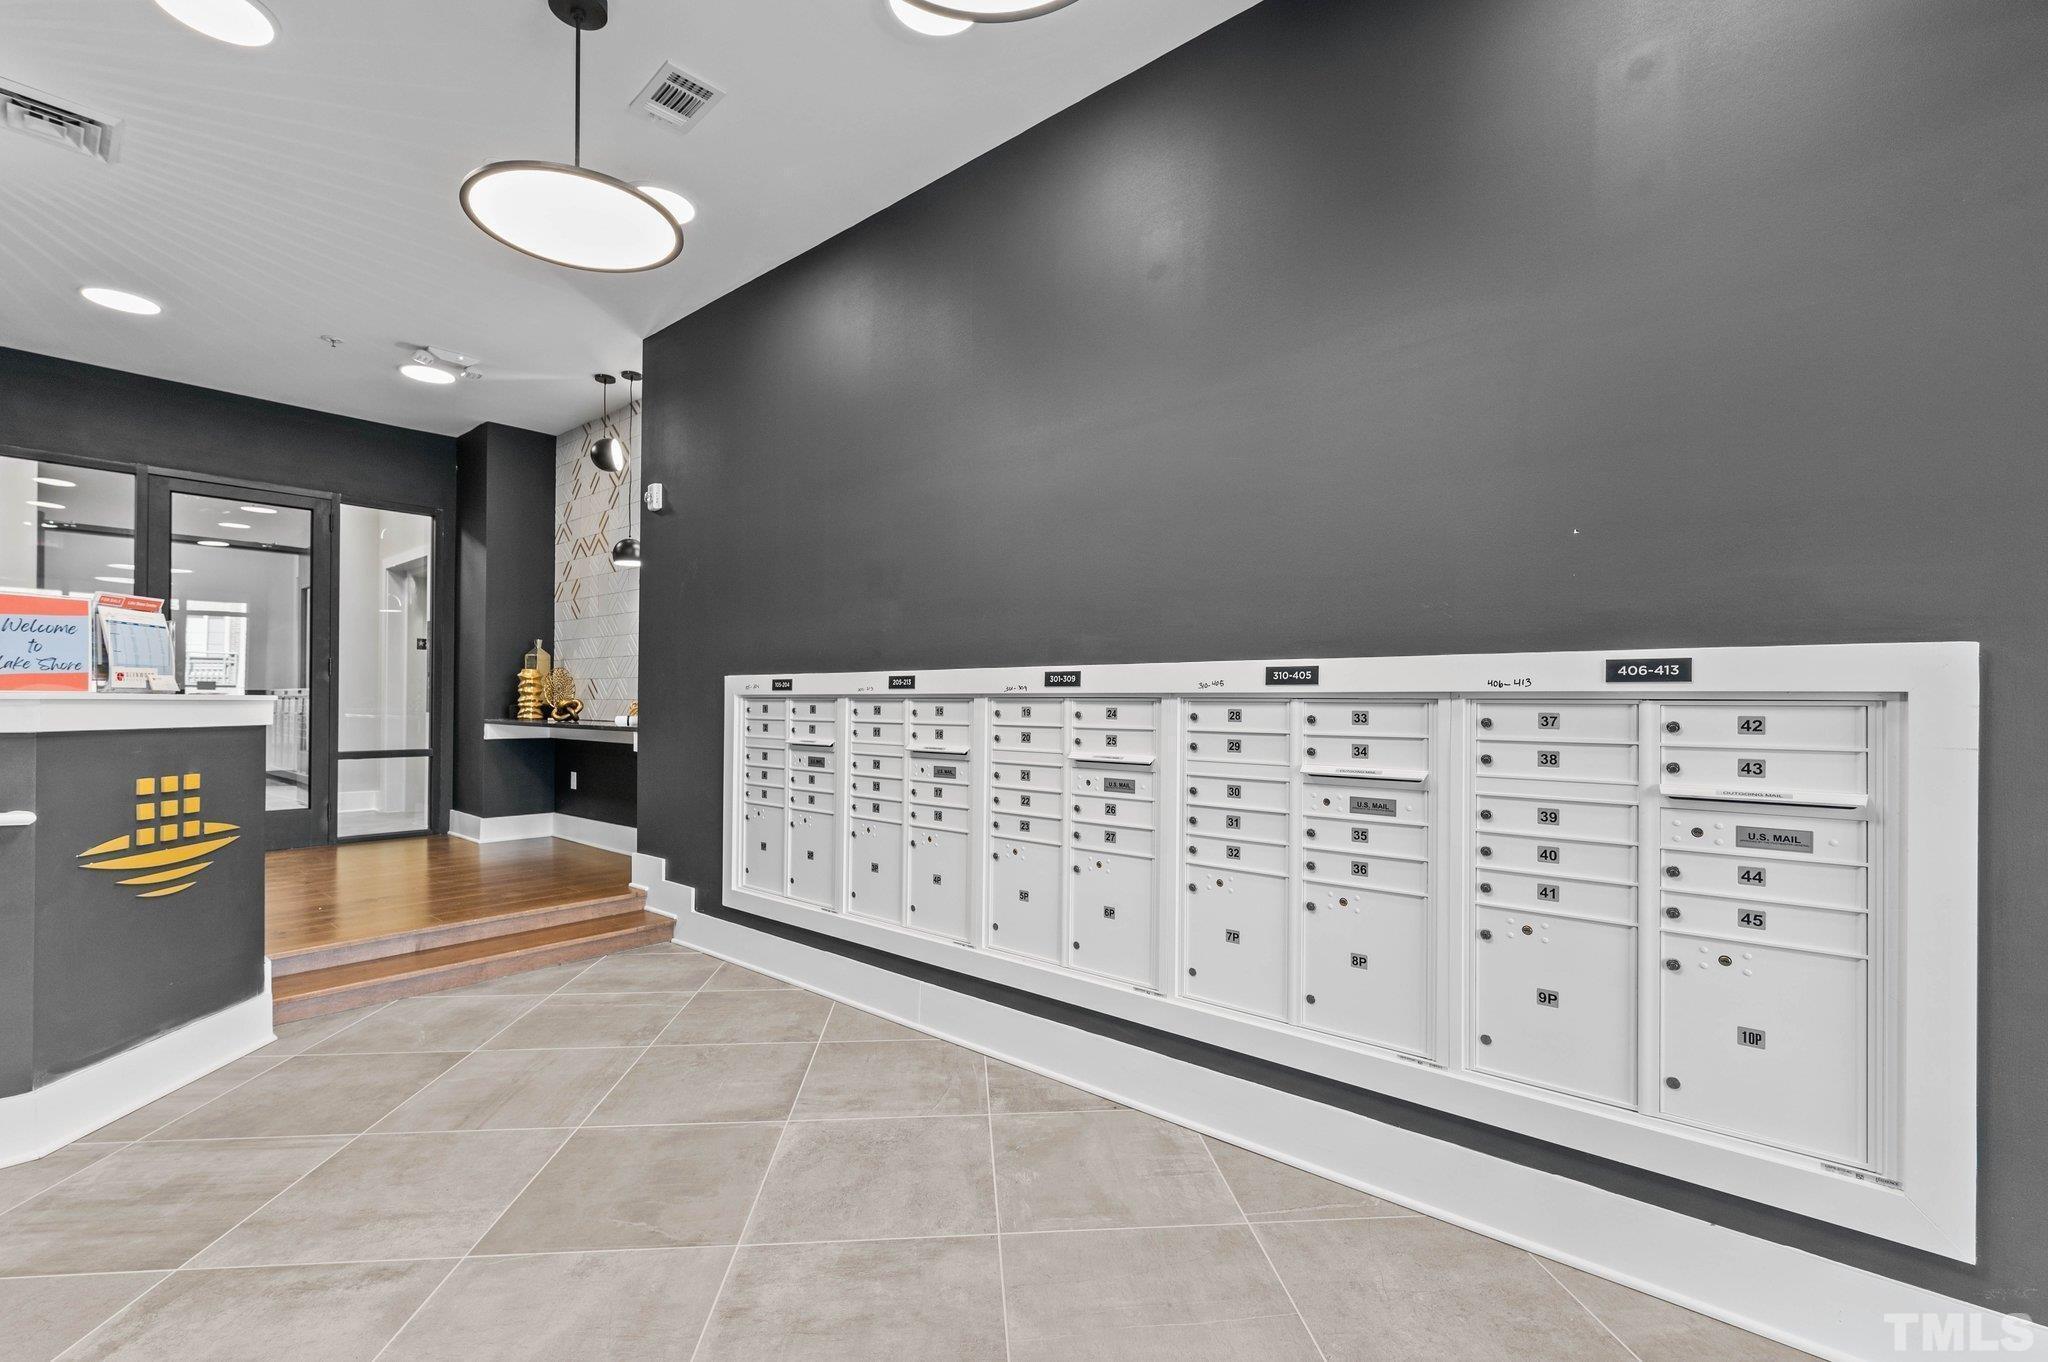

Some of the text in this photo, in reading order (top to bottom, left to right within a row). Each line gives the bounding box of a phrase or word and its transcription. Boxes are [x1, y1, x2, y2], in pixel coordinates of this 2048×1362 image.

[1, 618, 78, 635] Welcome
[28, 638, 43, 653] to
[36, 657, 82, 671] Shore
[1272, 670, 1312, 680] 310-405
[1617, 664, 1680, 676] 406-413
[892, 678, 912, 686] 205-213
[1049, 675, 1077, 683] 301-309
[936, 707, 944, 716] 15
[1022, 708, 1031, 717] 19
[1107, 709, 1117, 718] 24
[1229, 711, 1241, 721] 28
[1353, 713, 1368, 724] 33
[1540, 715, 1558, 727] 37
[1740, 719, 1763, 732] 42
[935, 729, 944, 740] 16
[1021, 732, 1031, 742] 20
[1106, 736, 1117, 746] 25
[1228, 741, 1241, 751] 29
[1353, 746, 1369, 757] 34
[1540, 753, 1558, 765] 38
[1740, 762, 1763, 775] 43
[1020, 770, 1030, 781] 21
[935, 788, 943, 797] 17
[1228, 785, 1240, 797] 30
[1020, 795, 1030, 806] 22
[1356, 801, 1371, 809] U.S.
[1371, 802, 1389, 811] MAIL
[1105, 805, 1116, 815] 26
[1540, 810, 1558, 823] 39
[1020, 820, 1030, 831] 23
[1227, 817, 1239, 828] 31
[1105, 832, 1116, 842] 27
[1353, 830, 1368, 841] 35
[1748, 832, 1770, 842] U.S.
[1772, 834, 1802, 844] MAIL
[1227, 847, 1240, 858] 32
[1539, 849, 1558, 862] 40
[1353, 863, 1367, 875] 36
[933, 876, 941, 884] 4P
[1740, 870, 1764, 884] 44
[1019, 891, 1029, 900] 5P
[1539, 887, 1556, 900] 41
[1104, 908, 1115, 917] 6P
[1740, 912, 1764, 927] 45
[1226, 931, 1240, 942] 7P
[1351, 955, 1367, 967] 8P
[1538, 991, 1558, 1005] 9P
[1741, 1030, 1762, 1046] 10P
